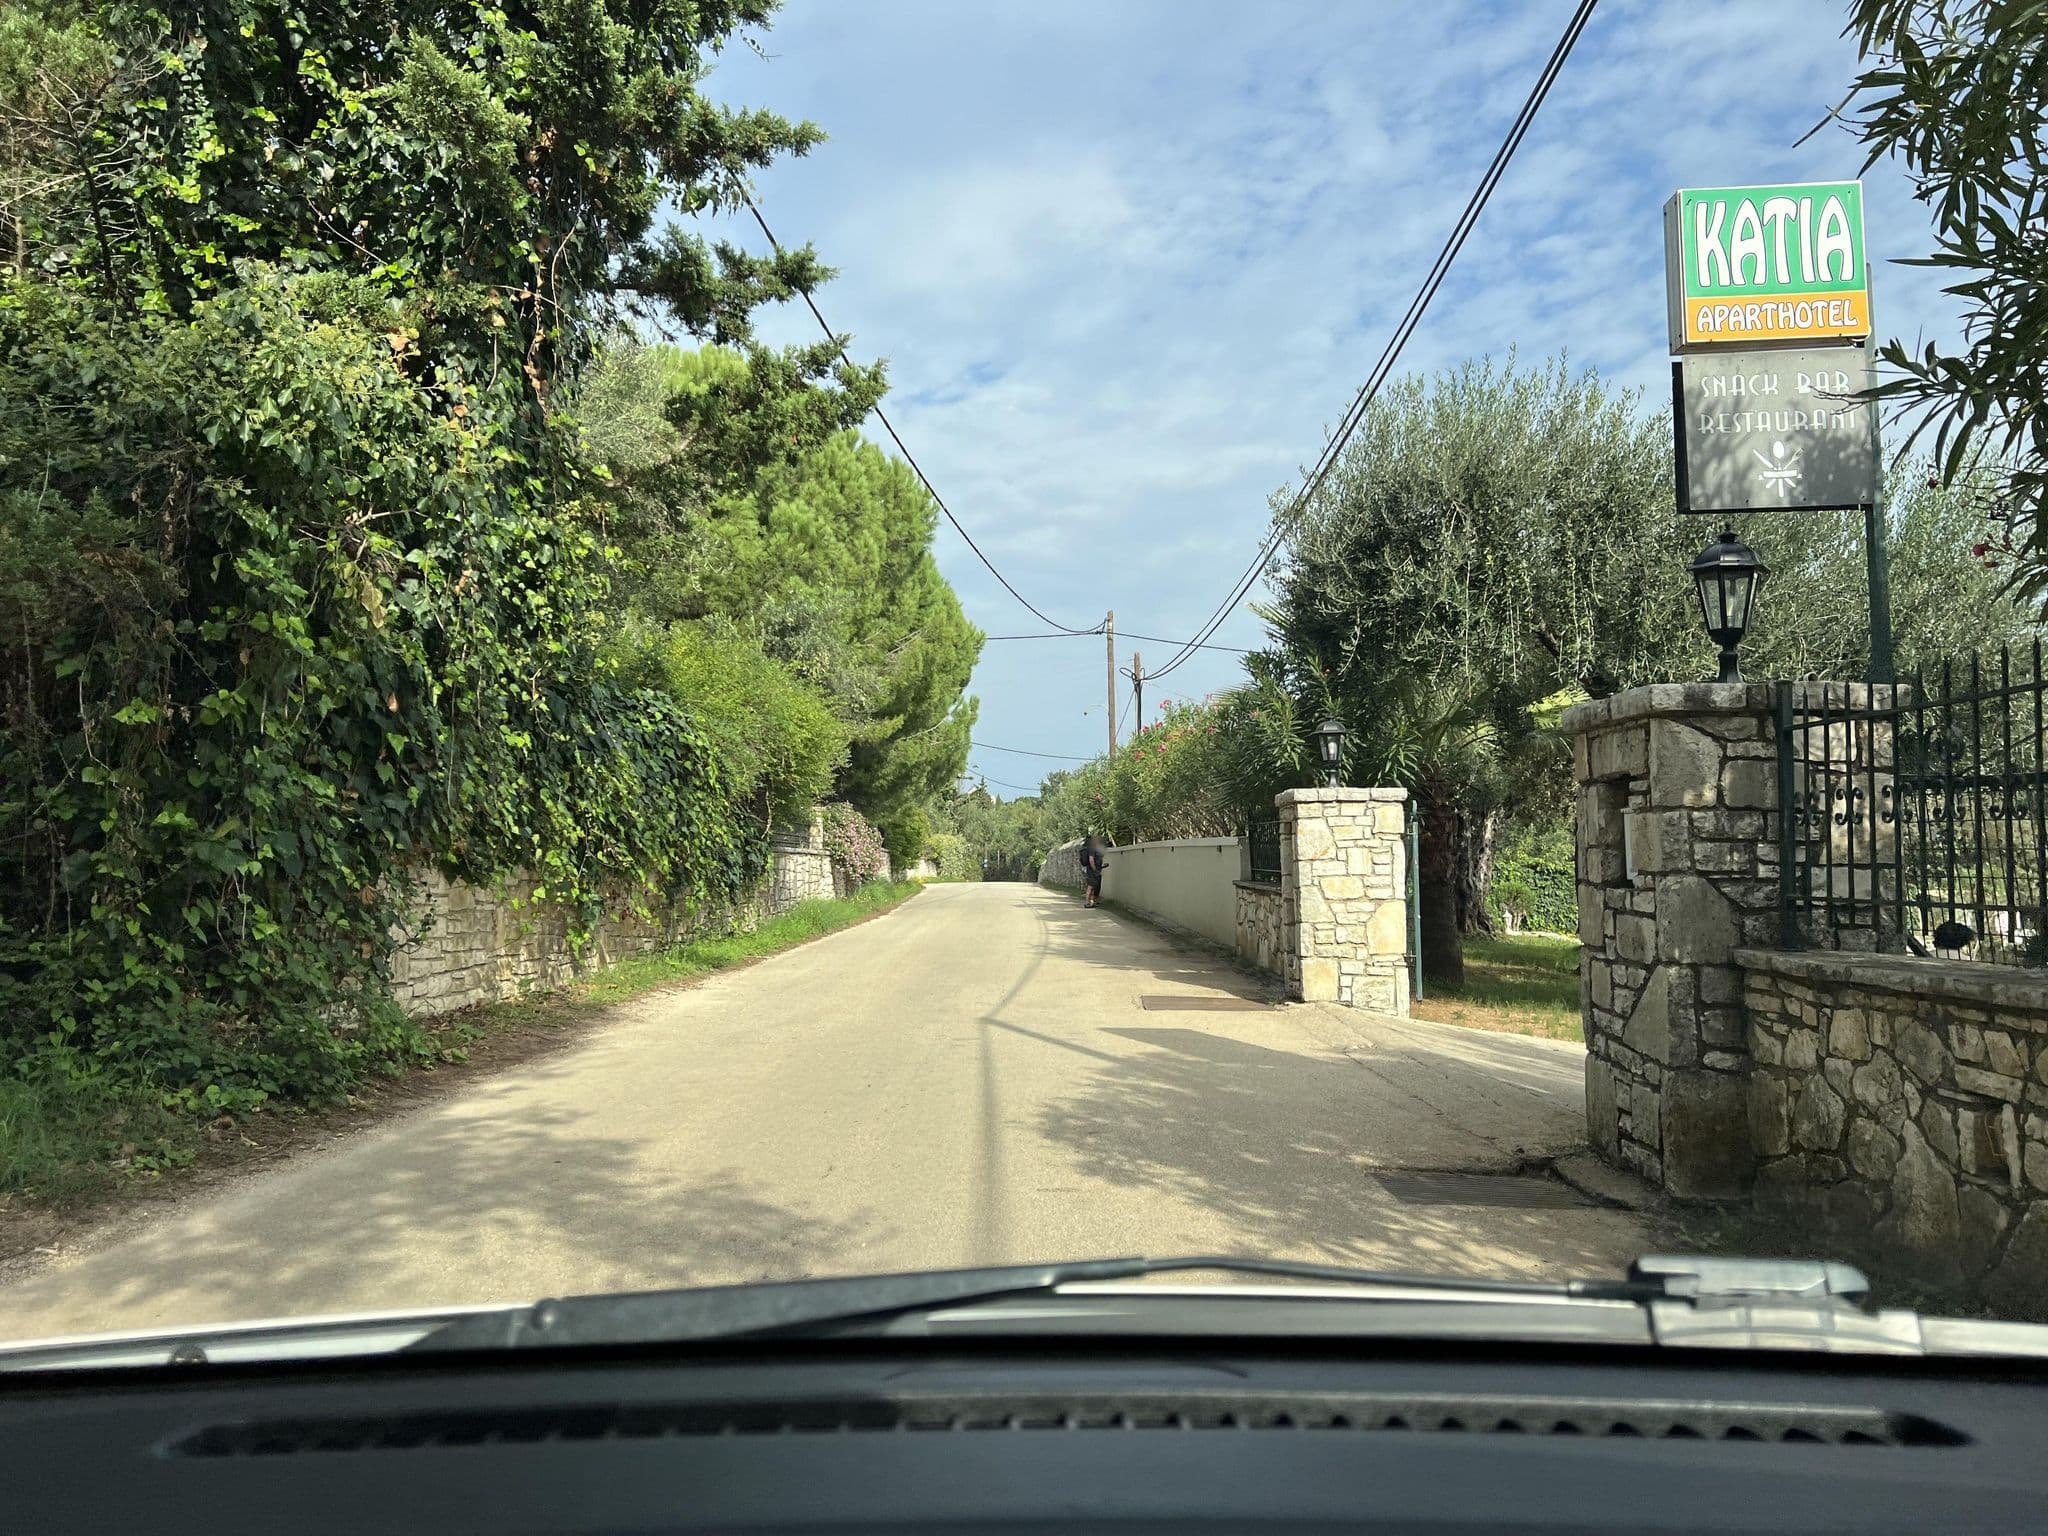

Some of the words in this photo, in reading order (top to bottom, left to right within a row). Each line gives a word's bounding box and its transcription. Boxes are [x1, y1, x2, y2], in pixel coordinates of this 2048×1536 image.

[1696, 195, 1855, 287] KATIA
[1697, 299, 1858, 332] APARTHOTEL
[1700, 373, 1779, 398] SNACK
[1794, 370, 1850, 394] BAR
[1698, 408, 1857, 434] RESTAURANT
